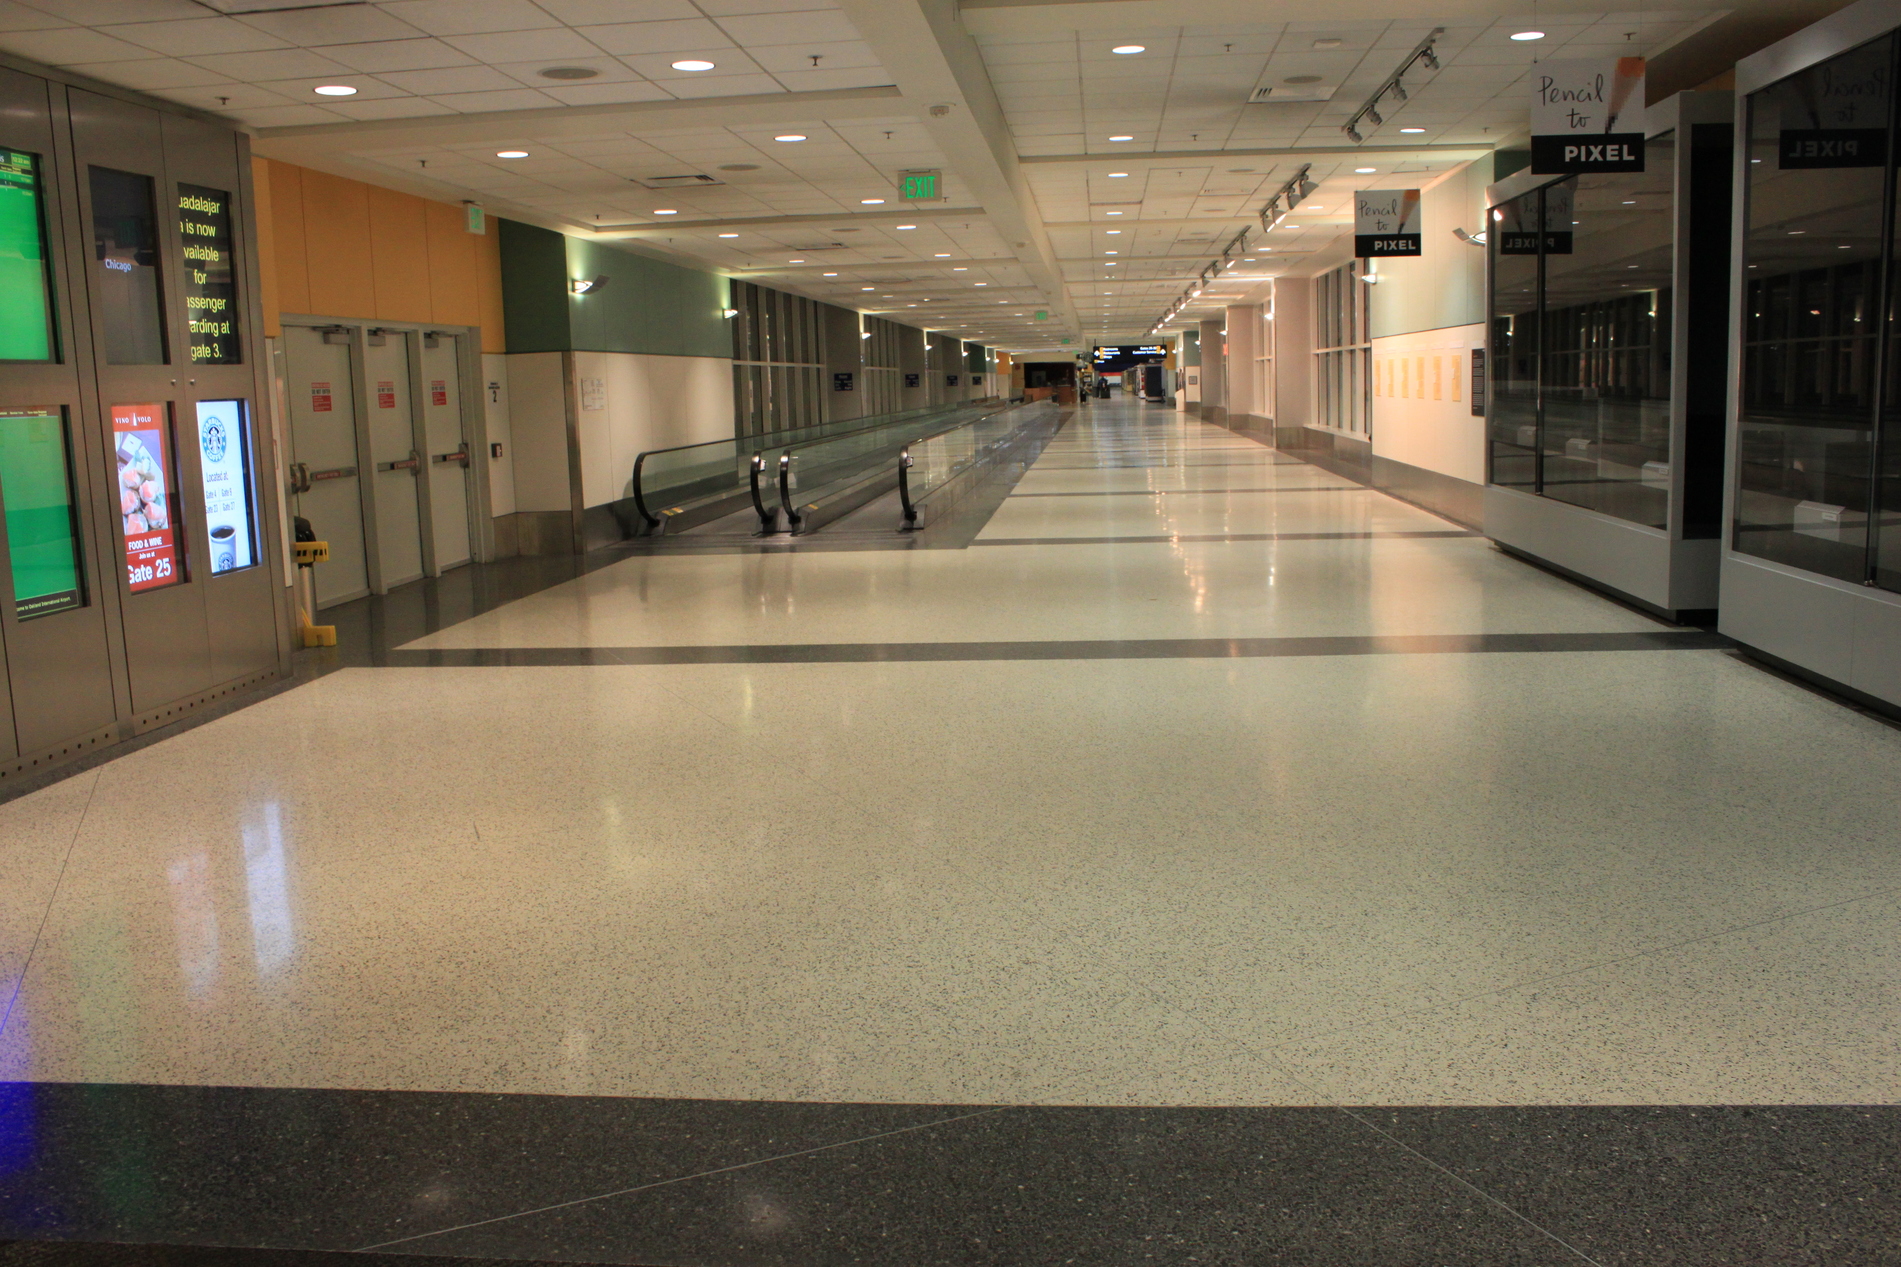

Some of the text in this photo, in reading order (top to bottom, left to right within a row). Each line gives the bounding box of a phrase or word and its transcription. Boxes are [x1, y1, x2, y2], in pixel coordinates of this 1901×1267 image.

[1538, 74, 1604, 106] Pencil
[1566, 108, 1591, 128] to
[1565, 144, 1635, 162] PIXEL
[906, 176, 936, 199] EXIT
[1358, 198, 1397, 218] Pencil
[186, 218, 195, 235] is
[196, 223, 217, 237] now
[1375, 219, 1390, 231] to
[183, 245, 220, 262] vailable
[1374, 240, 1416, 251] PIXEL
[105, 258, 132, 273] Chicago
[194, 268, 207, 285] for
[220, 320, 231, 334] at
[190, 343, 222, 361] gate 3.
[206, 471, 223, 483] Located
[128, 536, 163, 550] FOOD & WINE
[127, 557, 172, 584] Gate 25
